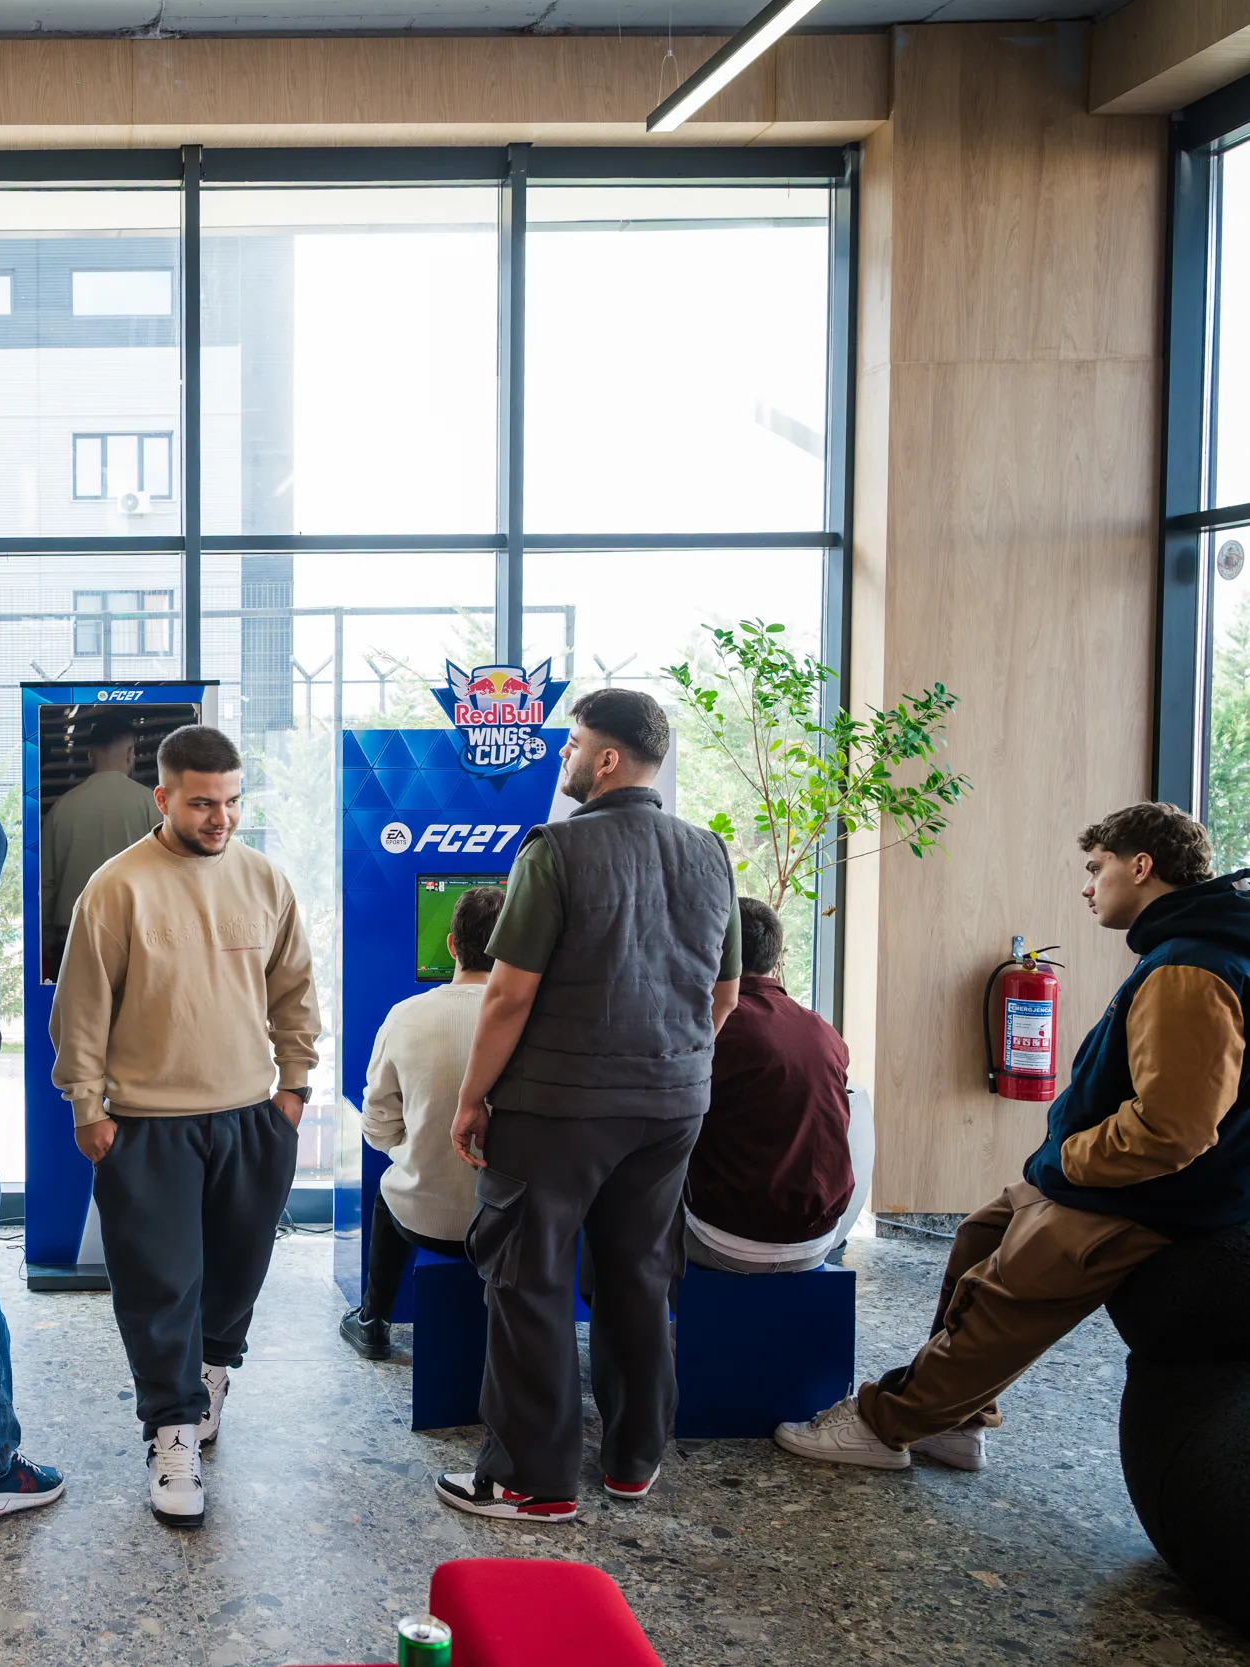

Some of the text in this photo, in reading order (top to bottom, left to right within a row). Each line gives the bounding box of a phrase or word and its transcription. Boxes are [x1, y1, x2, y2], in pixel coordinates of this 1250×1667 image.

[108, 690, 144, 701] FC27
[455, 702, 542, 725] Red Bull
[461, 726, 532, 746] WINGS
[475, 745, 520, 765] CUP
[386, 829, 406, 840] EA
[413, 824, 522, 853] FC27
